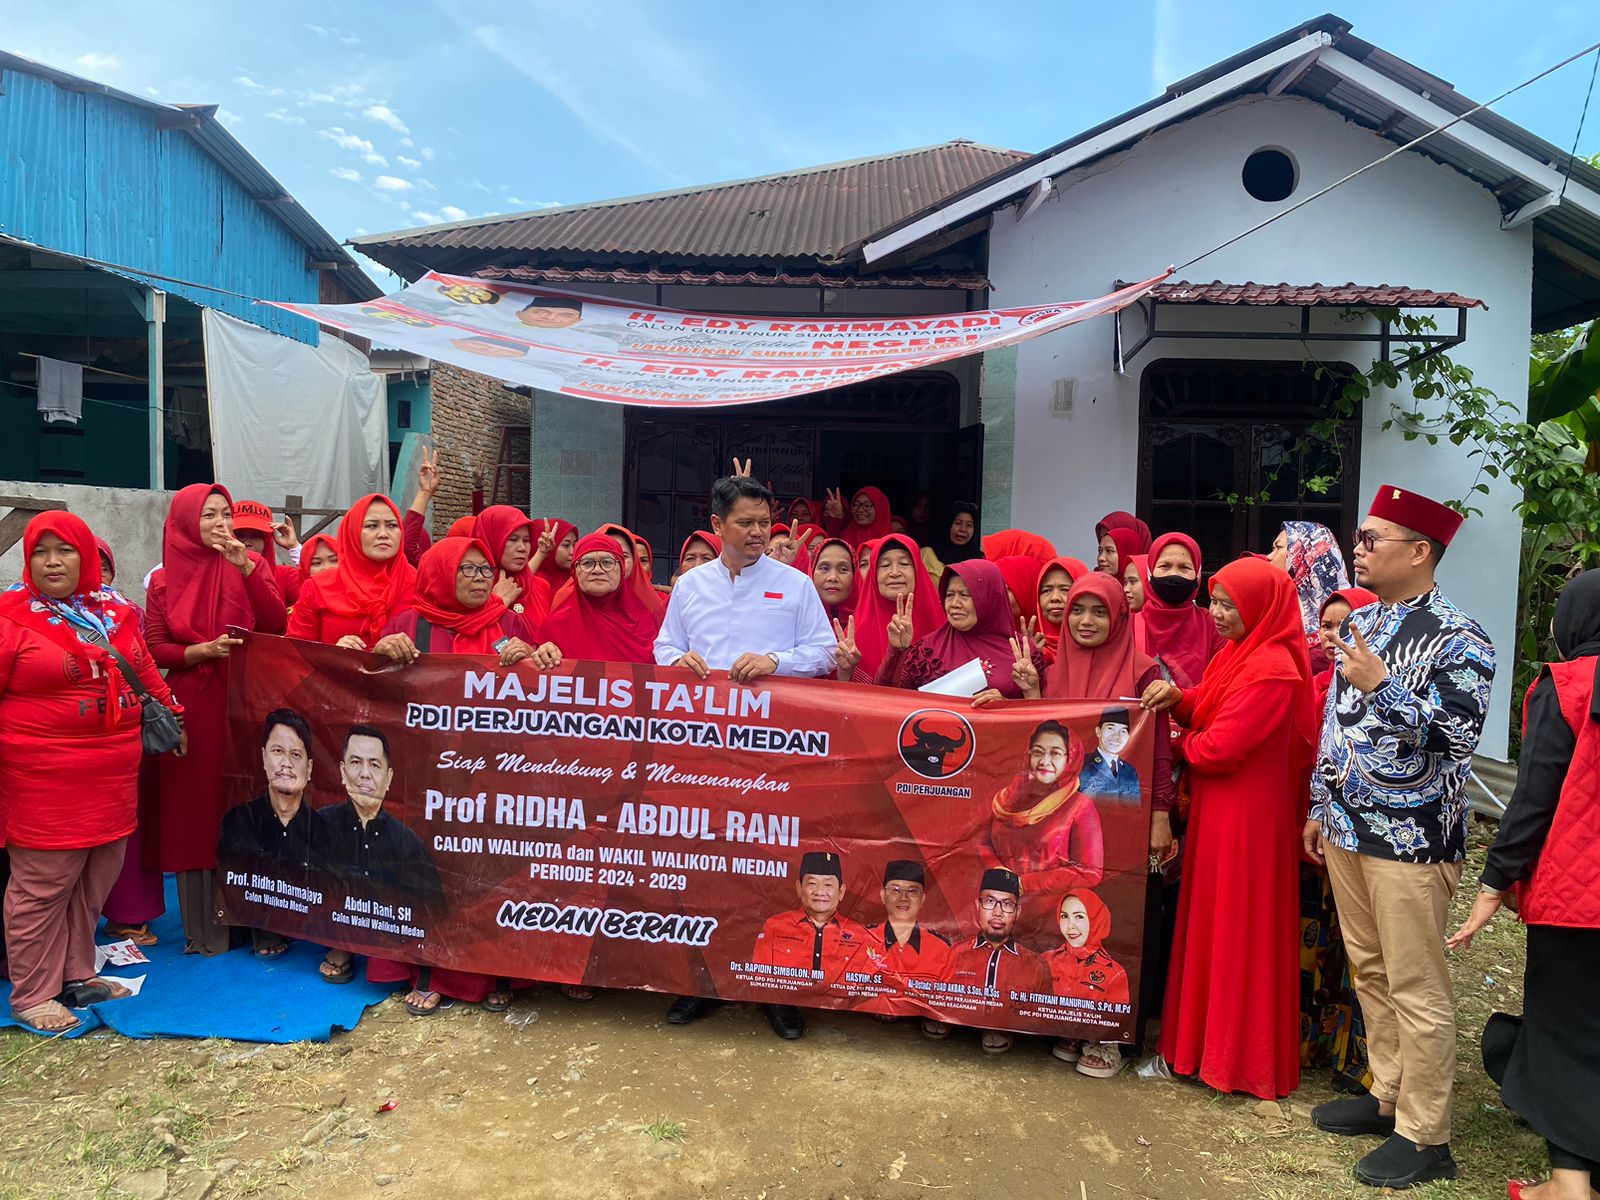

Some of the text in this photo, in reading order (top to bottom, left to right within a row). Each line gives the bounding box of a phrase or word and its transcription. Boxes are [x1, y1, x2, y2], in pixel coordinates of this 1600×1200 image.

[627, 321, 685, 331] CALON
[692, 327, 789, 337] GUBERNUR
[793, 329, 892, 338] SUMATERA
[898, 328, 956, 337] UTARA
[628, 311, 1000, 332] H. EDY RAHMAYADI
[629, 342, 743, 357] LANJUTKAN
[750, 349, 822, 358] SUMUT
[811, 334, 979, 350] NEGERI
[577, 364, 646, 377] CALON
[651, 373, 769, 384] GUBERNUR
[580, 357, 622, 369] H.
[640, 364, 731, 379] EDY
[464, 670, 772, 719] MAJELIS TA'LIM
[406, 703, 828, 756] PDI PERJUANGAN KOTA MEDAN
[436, 750, 790, 795] Siap Mendukung & Memenangkan
[896, 782, 971, 798] PDI PERJUANGAN
[424, 788, 800, 847] Prof RIDHA - ABDUL RANI
[433, 835, 788, 878] CALON WALIKOTA dan WAKIL WALIKOTA MEDAN
[530, 863, 594, 883] PERIODE
[598, 868, 634, 887] 2024
[649, 872, 687, 891] 2029
[226, 871, 323, 905] Prof. Ridha Dharmajaya
[244, 891, 261, 903] Calon
[290, 900, 309, 914] Medan
[345, 896, 412, 922] Abdul Rani, SH
[332, 911, 425, 938] Calon Wakil Walikota Medan
[497, 901, 717, 945] MEDAN BERANI
[730, 961, 824, 980] Drs. RAPIDIN SIMBOLON, MM
[873, 974, 883, 984] SE
[750, 981, 779, 990] SUMATERA
[777, 978, 813, 987] PERJUANGAN
[865, 986, 896, 994] PERJUANGAN
[954, 997, 985, 1005] PERJUANGAN
[1010, 990, 1018, 1000] Dr.
[1019, 992, 1028, 1002] Hj.
[1029, 993, 1058, 1006] FITRIYANI
[1115, 1004, 1130, 1014] M.Pd
[1043, 1012, 1081, 1023] PERJUANGAN
[1082, 1017, 1098, 1025] KOTA
[1099, 1019, 1120, 1028] MEDAN
[1058, 1009, 1082, 1017] MAJELIS
